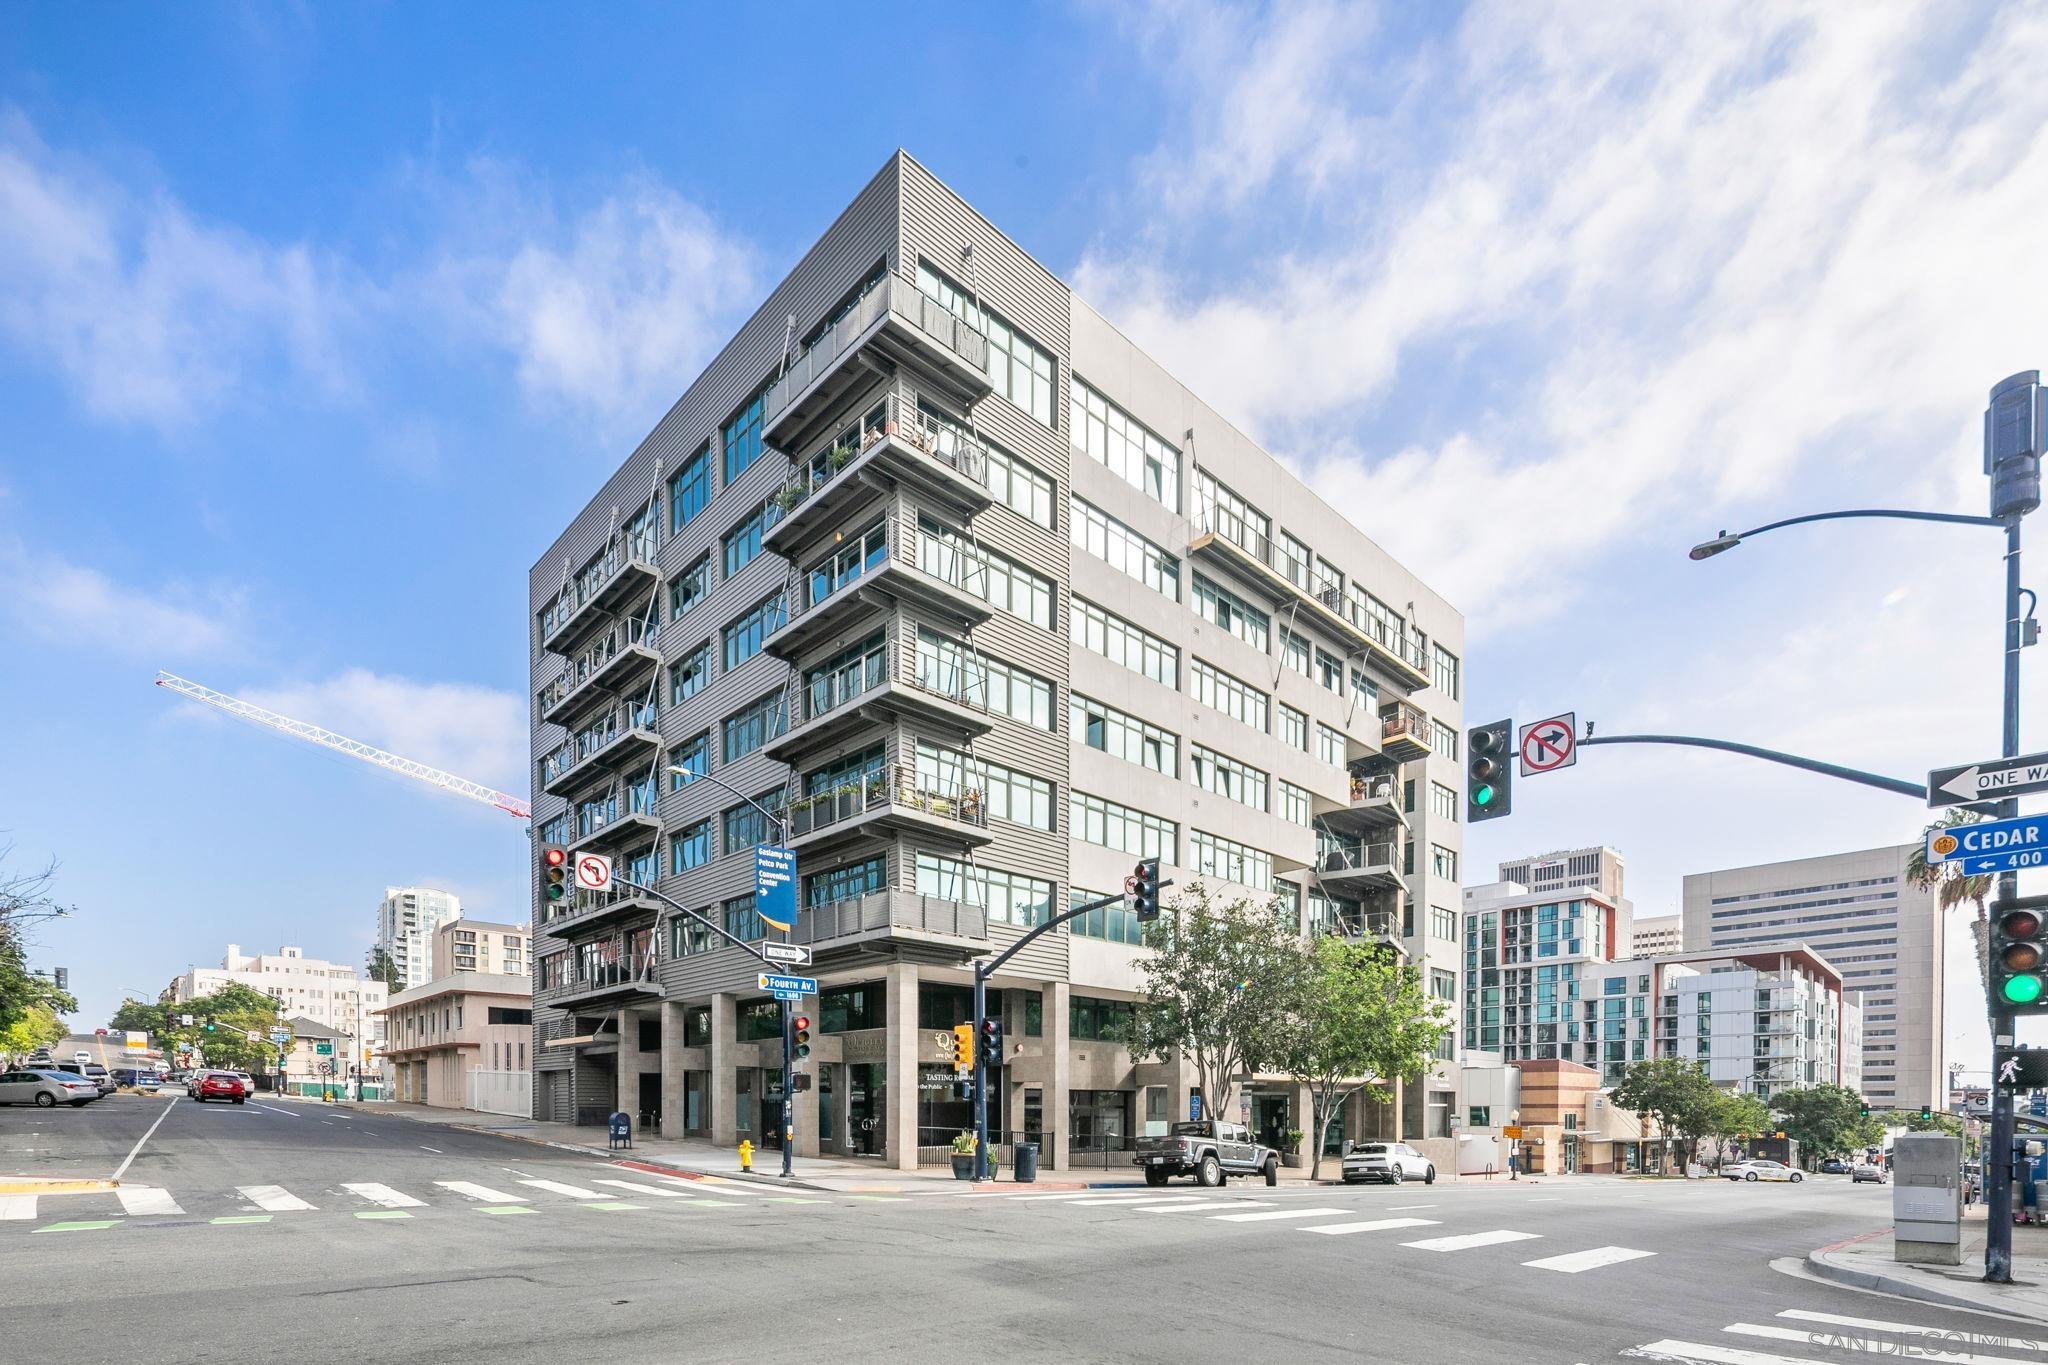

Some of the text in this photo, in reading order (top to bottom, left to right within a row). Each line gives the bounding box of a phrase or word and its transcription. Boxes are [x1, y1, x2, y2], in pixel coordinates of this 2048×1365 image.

[1979, 770, 2018, 788] ONE
[1963, 826, 2040, 851] CEDAR
[758, 847, 794, 861] Gaslamp Qtr
[2008, 851, 2042, 867] 400
[758, 858, 789, 870] Petco Park
[758, 870, 791, 881] Convention
[758, 878, 778, 887] Center
[770, 949, 782, 957] ONE
[926, 1073, 954, 1081] TASTING
